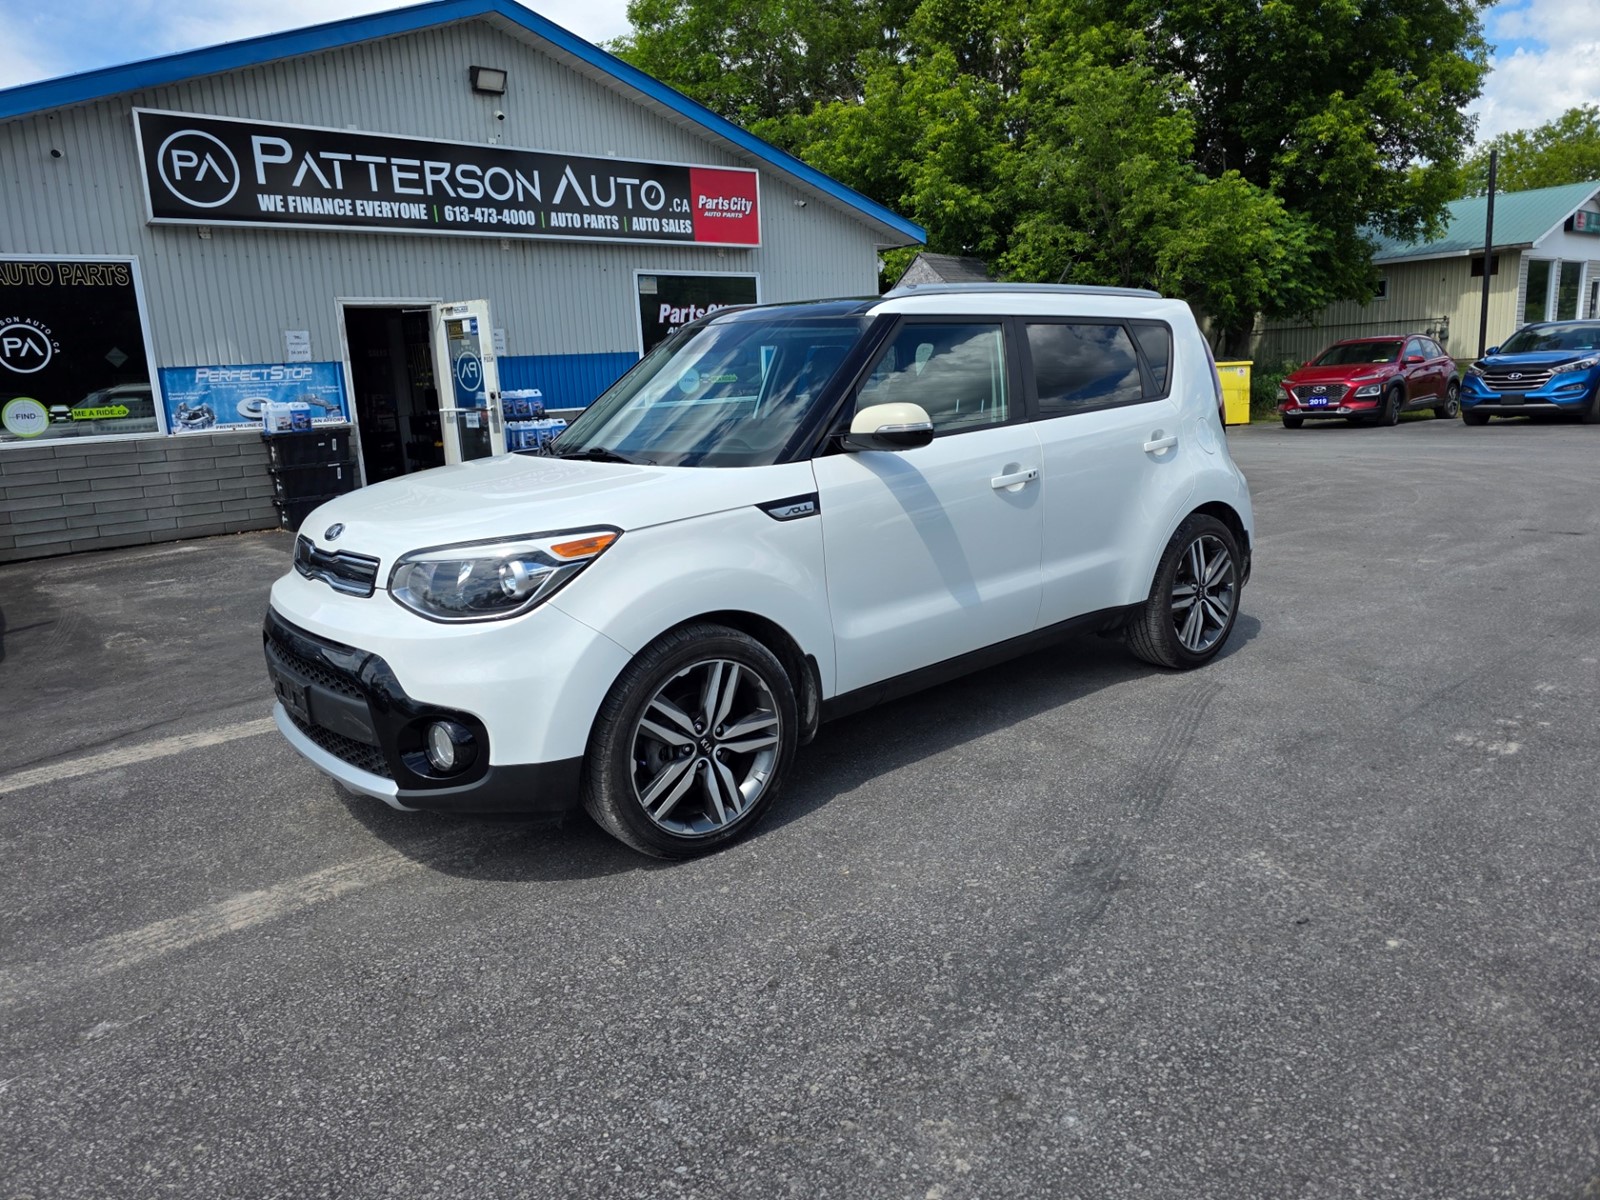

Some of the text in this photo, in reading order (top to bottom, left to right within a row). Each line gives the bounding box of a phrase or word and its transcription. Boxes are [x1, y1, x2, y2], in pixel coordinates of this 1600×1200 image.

[171, 149, 229, 183] PA
[251, 135, 542, 203] PATTERSON
[552, 164, 666, 211] AUTO
[256, 194, 692, 234] WE FINANCE EVERYONE 613-473-4000 AUTO PARTS AUTO SALES
[58, 264, 129, 286] PARTS
[0, 316, 20, 327] SON
[25, 317, 52, 335] AUTO
[701, 738, 712, 753] KIA
